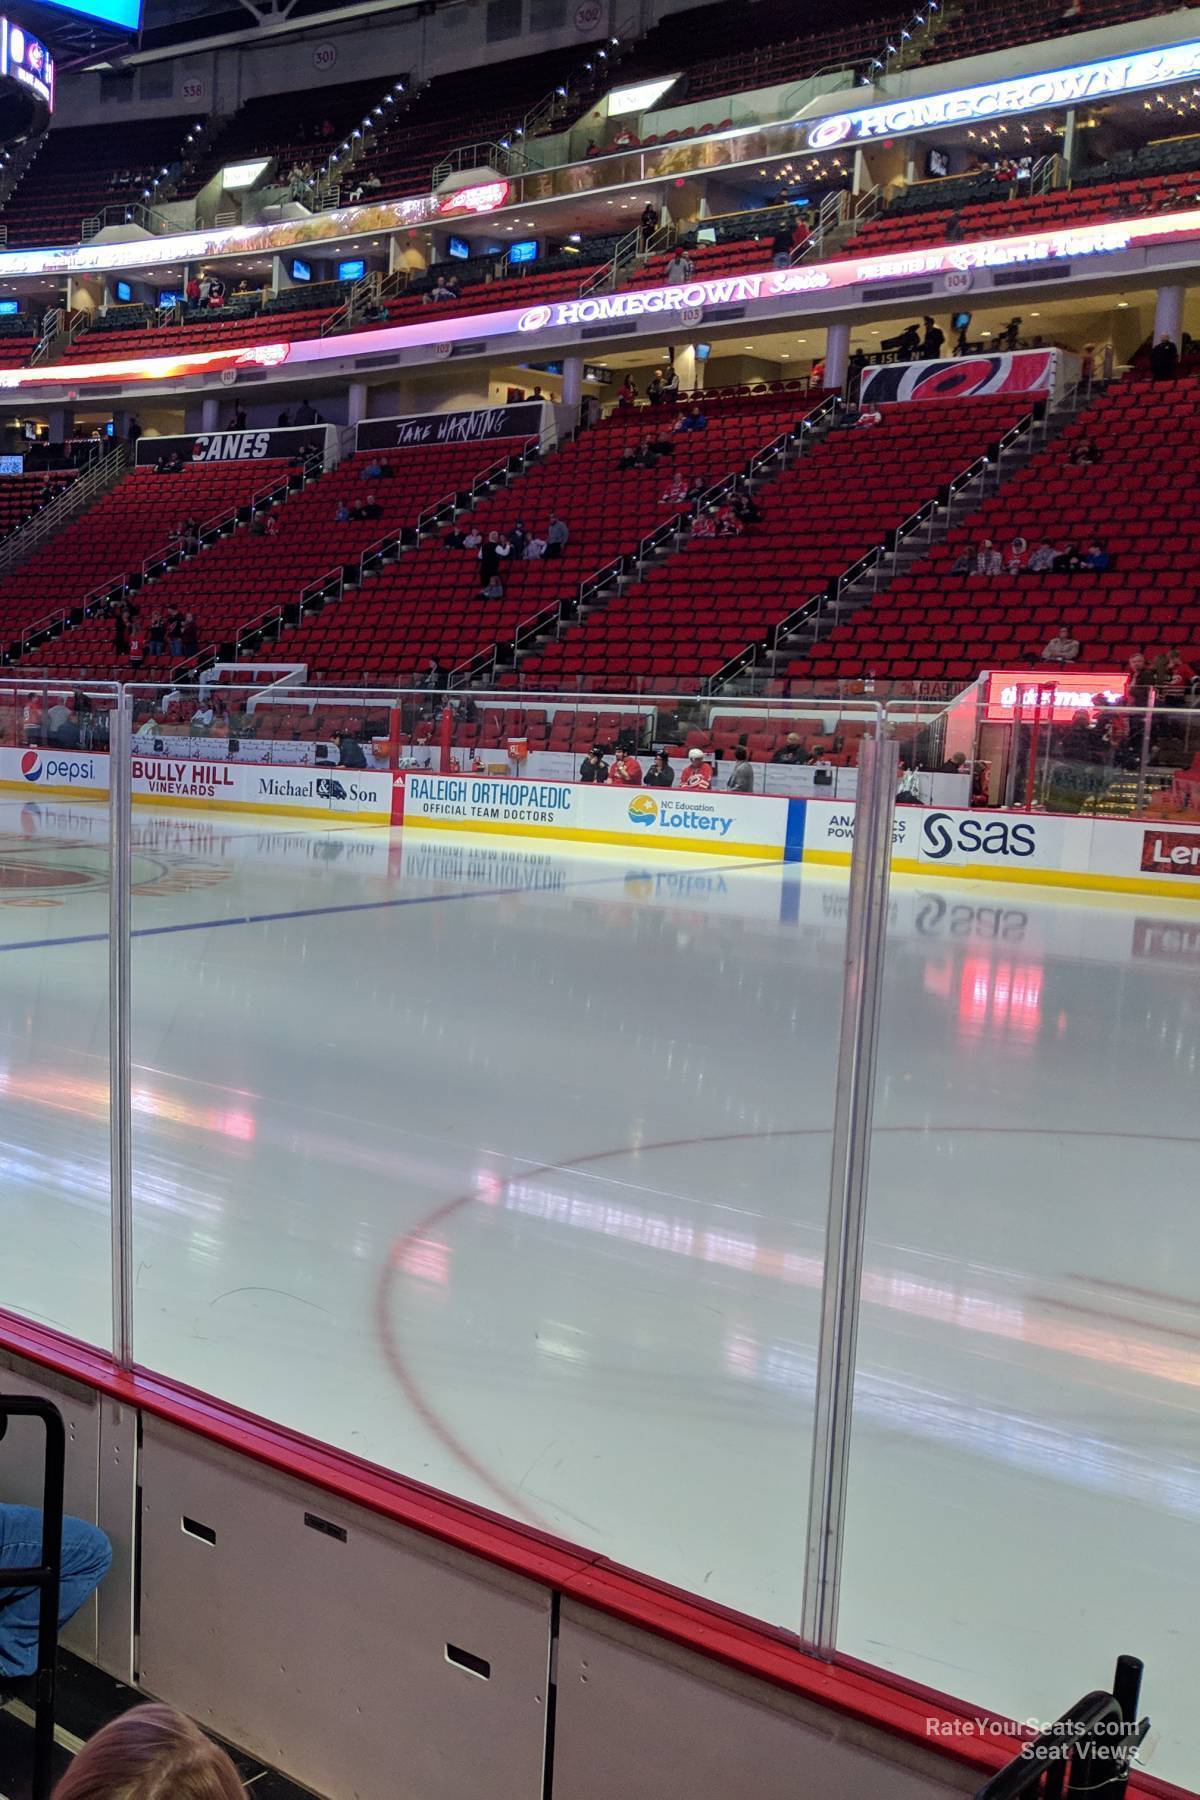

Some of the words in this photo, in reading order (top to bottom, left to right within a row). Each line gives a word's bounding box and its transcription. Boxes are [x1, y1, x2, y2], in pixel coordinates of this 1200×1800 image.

[856, 62, 1132, 137] HOMEGROWN
[556, 276, 765, 325] HOMEGROWN
[768, 269, 831, 294] Series
[857, 256, 926, 280] PRESENTED
[947, 275, 968, 288] 104
[396, 421, 432, 445] TAKE
[437, 408, 511, 445] WARNING
[192, 432, 270, 461] CANES
[46, 759, 94, 782] pepsi
[132, 761, 187, 783] BULLY
[192, 766, 234, 786] HILL
[148, 781, 216, 797] VINEYARDS
[259, 777, 313, 798] Michael
[318, 779, 331, 793] &
[349, 786, 378, 803] Son
[410, 777, 467, 803] RALEIGH
[471, 782, 572, 811] ORTHOPAEDIC
[422, 802, 467, 817] OFFICIAL
[470, 805, 500, 820] TEAM
[503, 807, 555, 823] DOCTORS
[660, 800, 674, 811] NC
[675, 801, 715, 813] Education
[660, 809, 732, 836] Lottery
[957, 818, 1036, 857] sas
